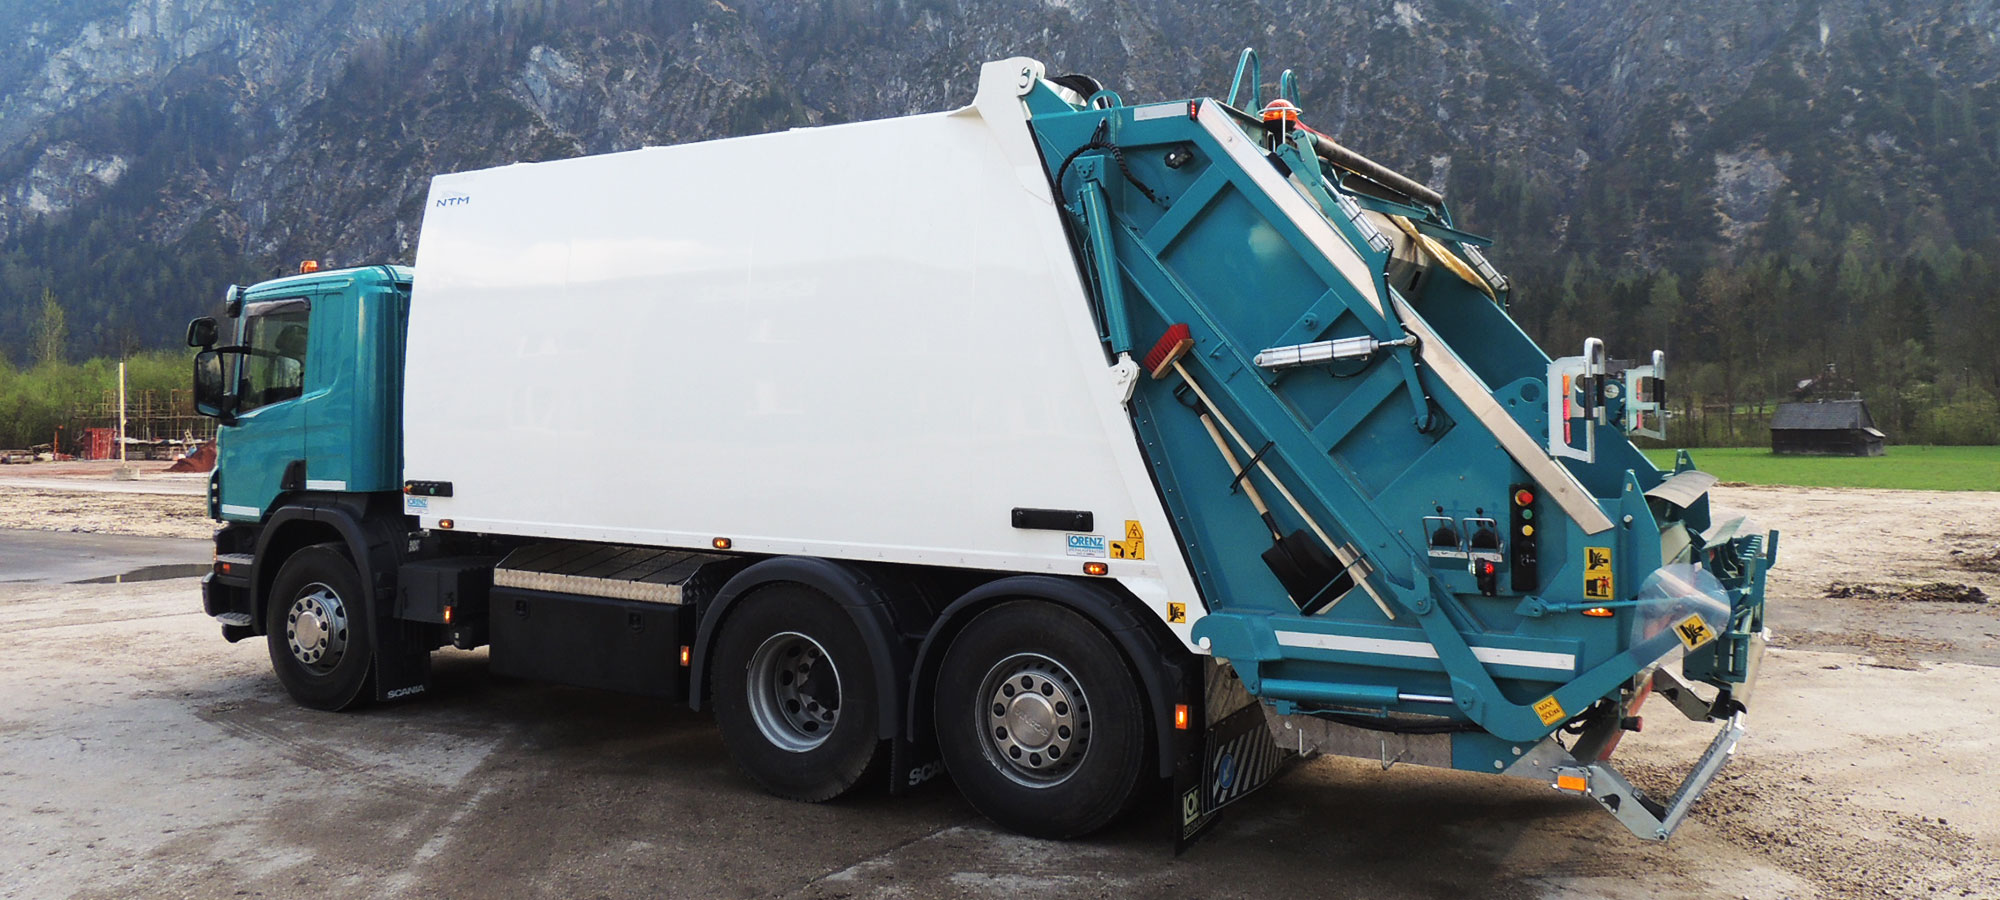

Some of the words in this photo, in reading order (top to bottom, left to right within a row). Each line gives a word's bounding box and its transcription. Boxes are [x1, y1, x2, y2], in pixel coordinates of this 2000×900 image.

[436, 196, 470, 207] NTM
[1067, 535, 1104, 549] LORENZ
[387, 684, 425, 699] SCANIA
[1538, 701, 1553, 711] MAX
